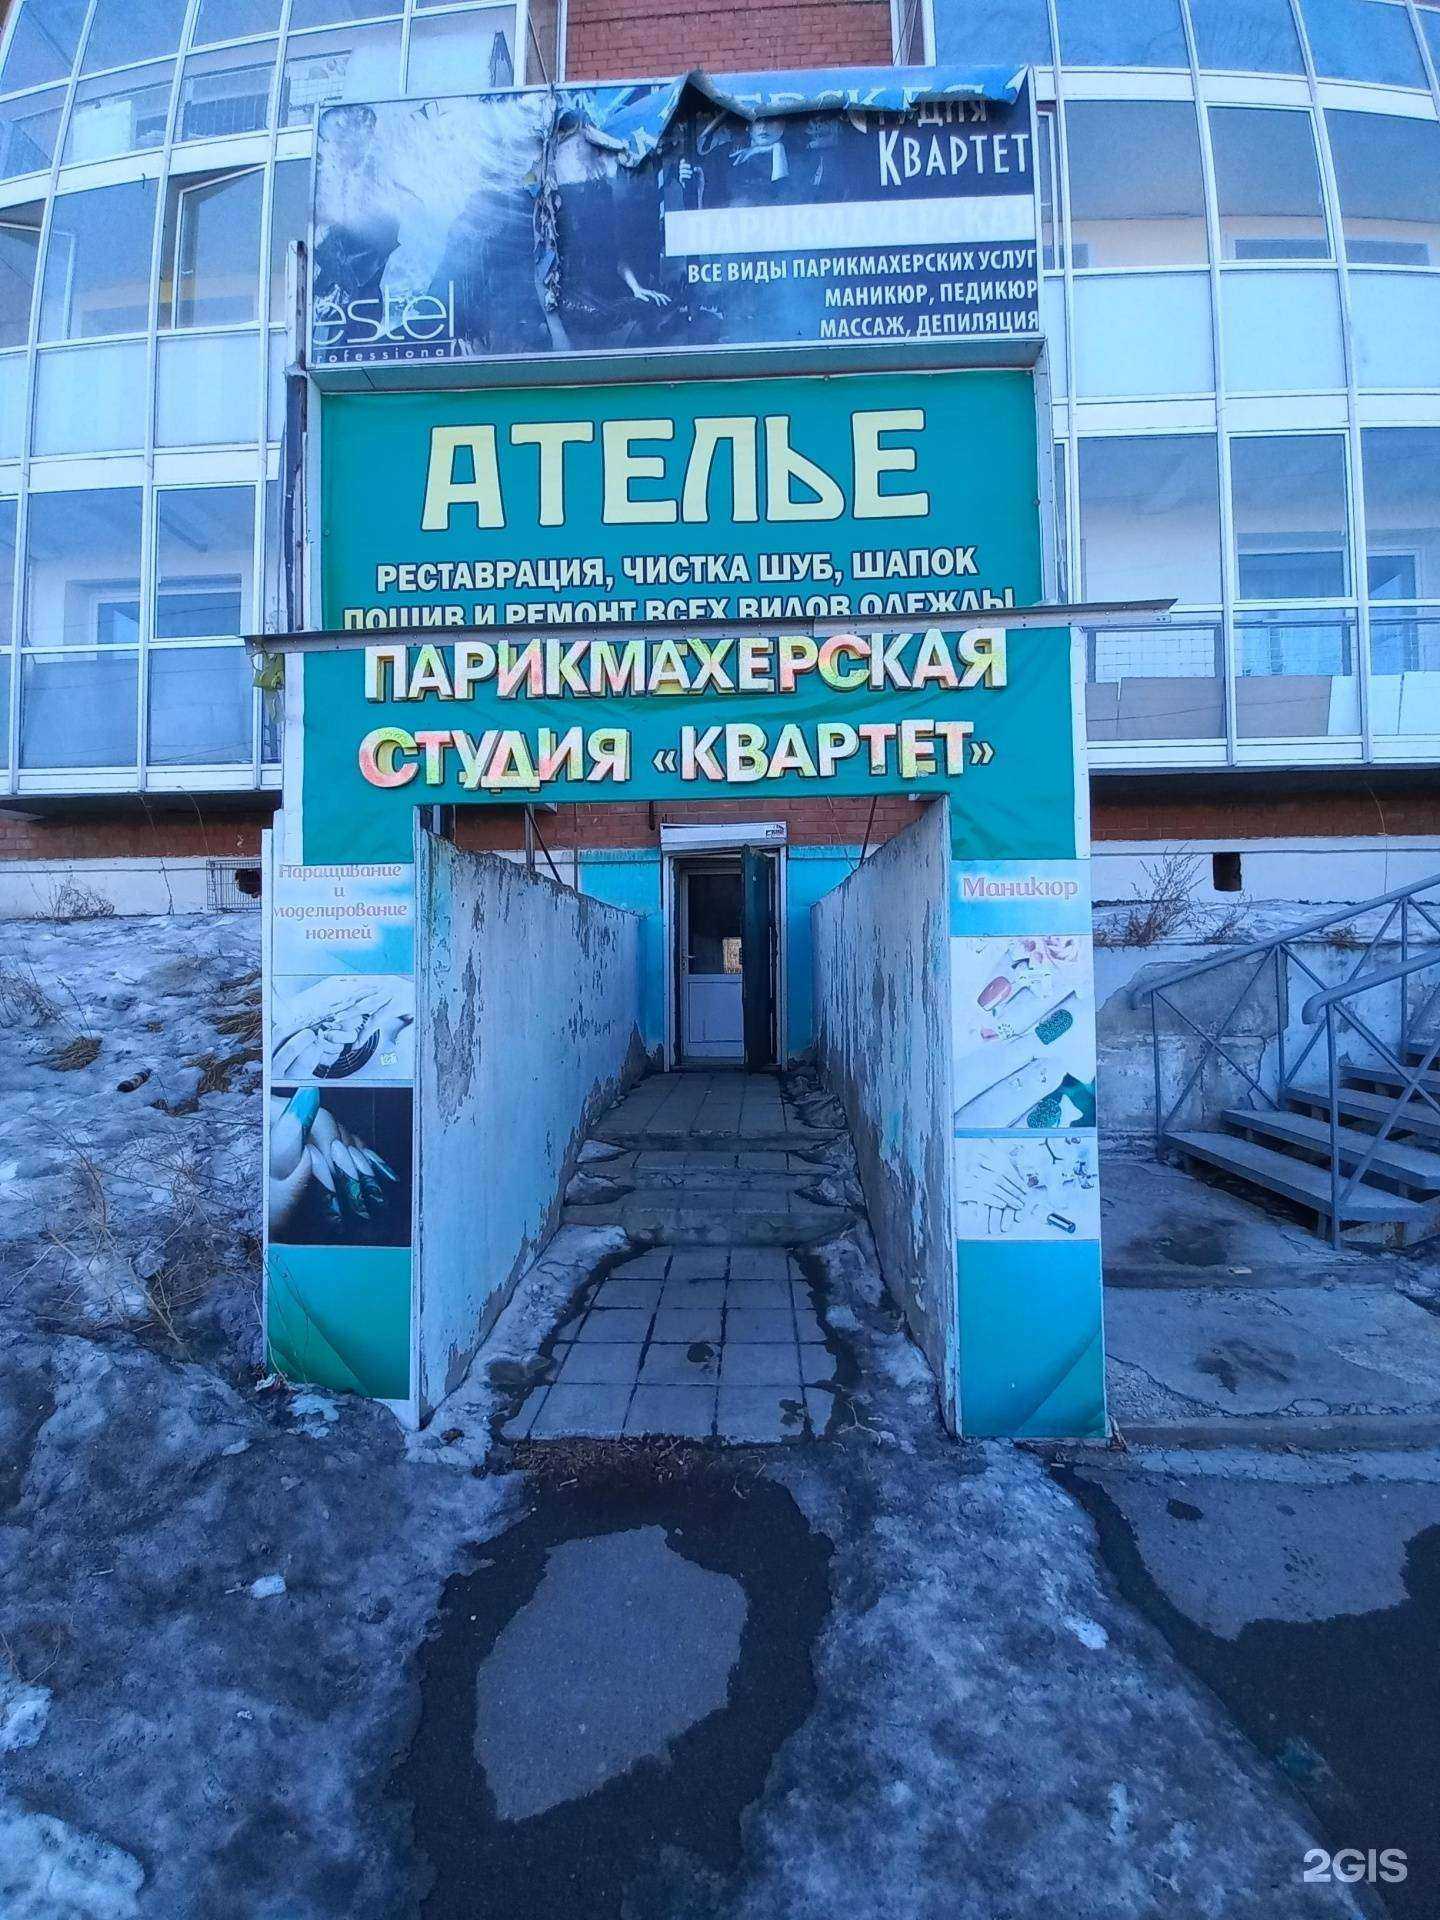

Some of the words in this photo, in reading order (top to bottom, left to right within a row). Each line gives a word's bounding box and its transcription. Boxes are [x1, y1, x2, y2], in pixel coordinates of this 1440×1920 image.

[688, 263, 722, 284] ВСЕ
[727, 260, 787, 283] ВИДЫ
[792, 249, 974, 278] ПАРИКМАХЕРСКИХ
[979, 249, 1036, 270] УСЛУГ
[825, 285, 934, 307] МАНИКЮР,
[940, 280, 1038, 304] ПЕДИКЮР
[313, 280, 455, 345] estel
[820, 315, 911, 338] МАССАЖ,
[917, 310, 1040, 337] ДЕПИЛЯЦИЯ
[422, 409, 929, 531] АТЕЛЬЕ
[377, 557, 614, 591] РЕСТАВРАЦИЯ,
[623, 554, 750, 585] ЧИСТКА
[758, 551, 842, 584] ШУБ,
[853, 547, 978, 579] ШАПОК
[344, 606, 464, 630] ПОШИВ
[474, 605, 494, 626] И
[506, 600, 636, 624] РЕМОНТ
[646, 598, 728, 622] ВСЕХ
[365, 628, 1008, 701] ПАРИКМАХЕРСКАЯ
[359, 726, 630, 792] СТУДИЯ
[652, 718, 994, 782] «КВАРТЕТ»
[334, 886, 345, 897] и
[963, 876, 1078, 900] Маникюр
[306, 923, 372, 940] ногтей
